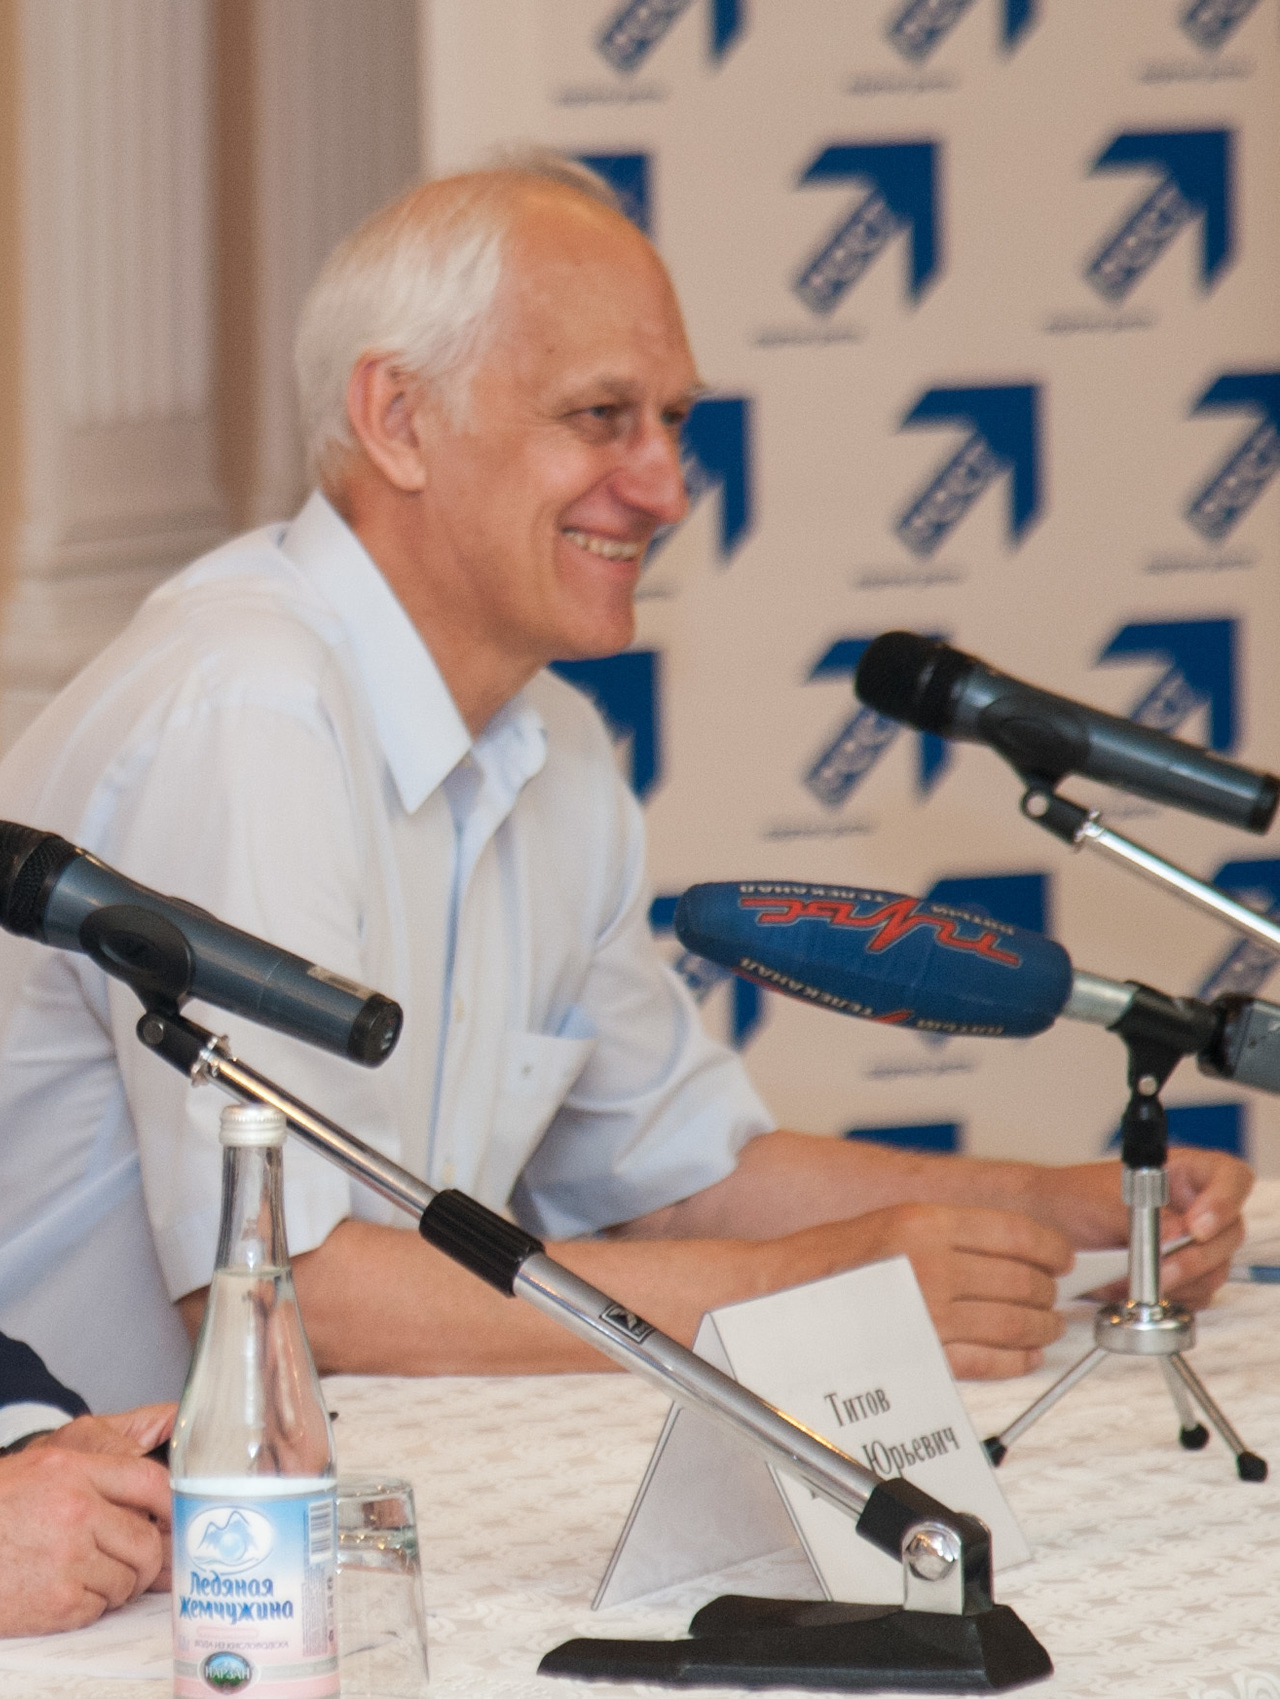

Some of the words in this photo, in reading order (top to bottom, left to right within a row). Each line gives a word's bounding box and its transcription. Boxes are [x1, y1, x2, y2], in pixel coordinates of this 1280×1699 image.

[740, 957, 874, 1017] ТЕЛЕКАНАЛ
[824, 1388, 891, 1427] Титов
[862, 1427, 961, 1478] Юрьевич
[190, 1570, 273, 1597] Ледяная
